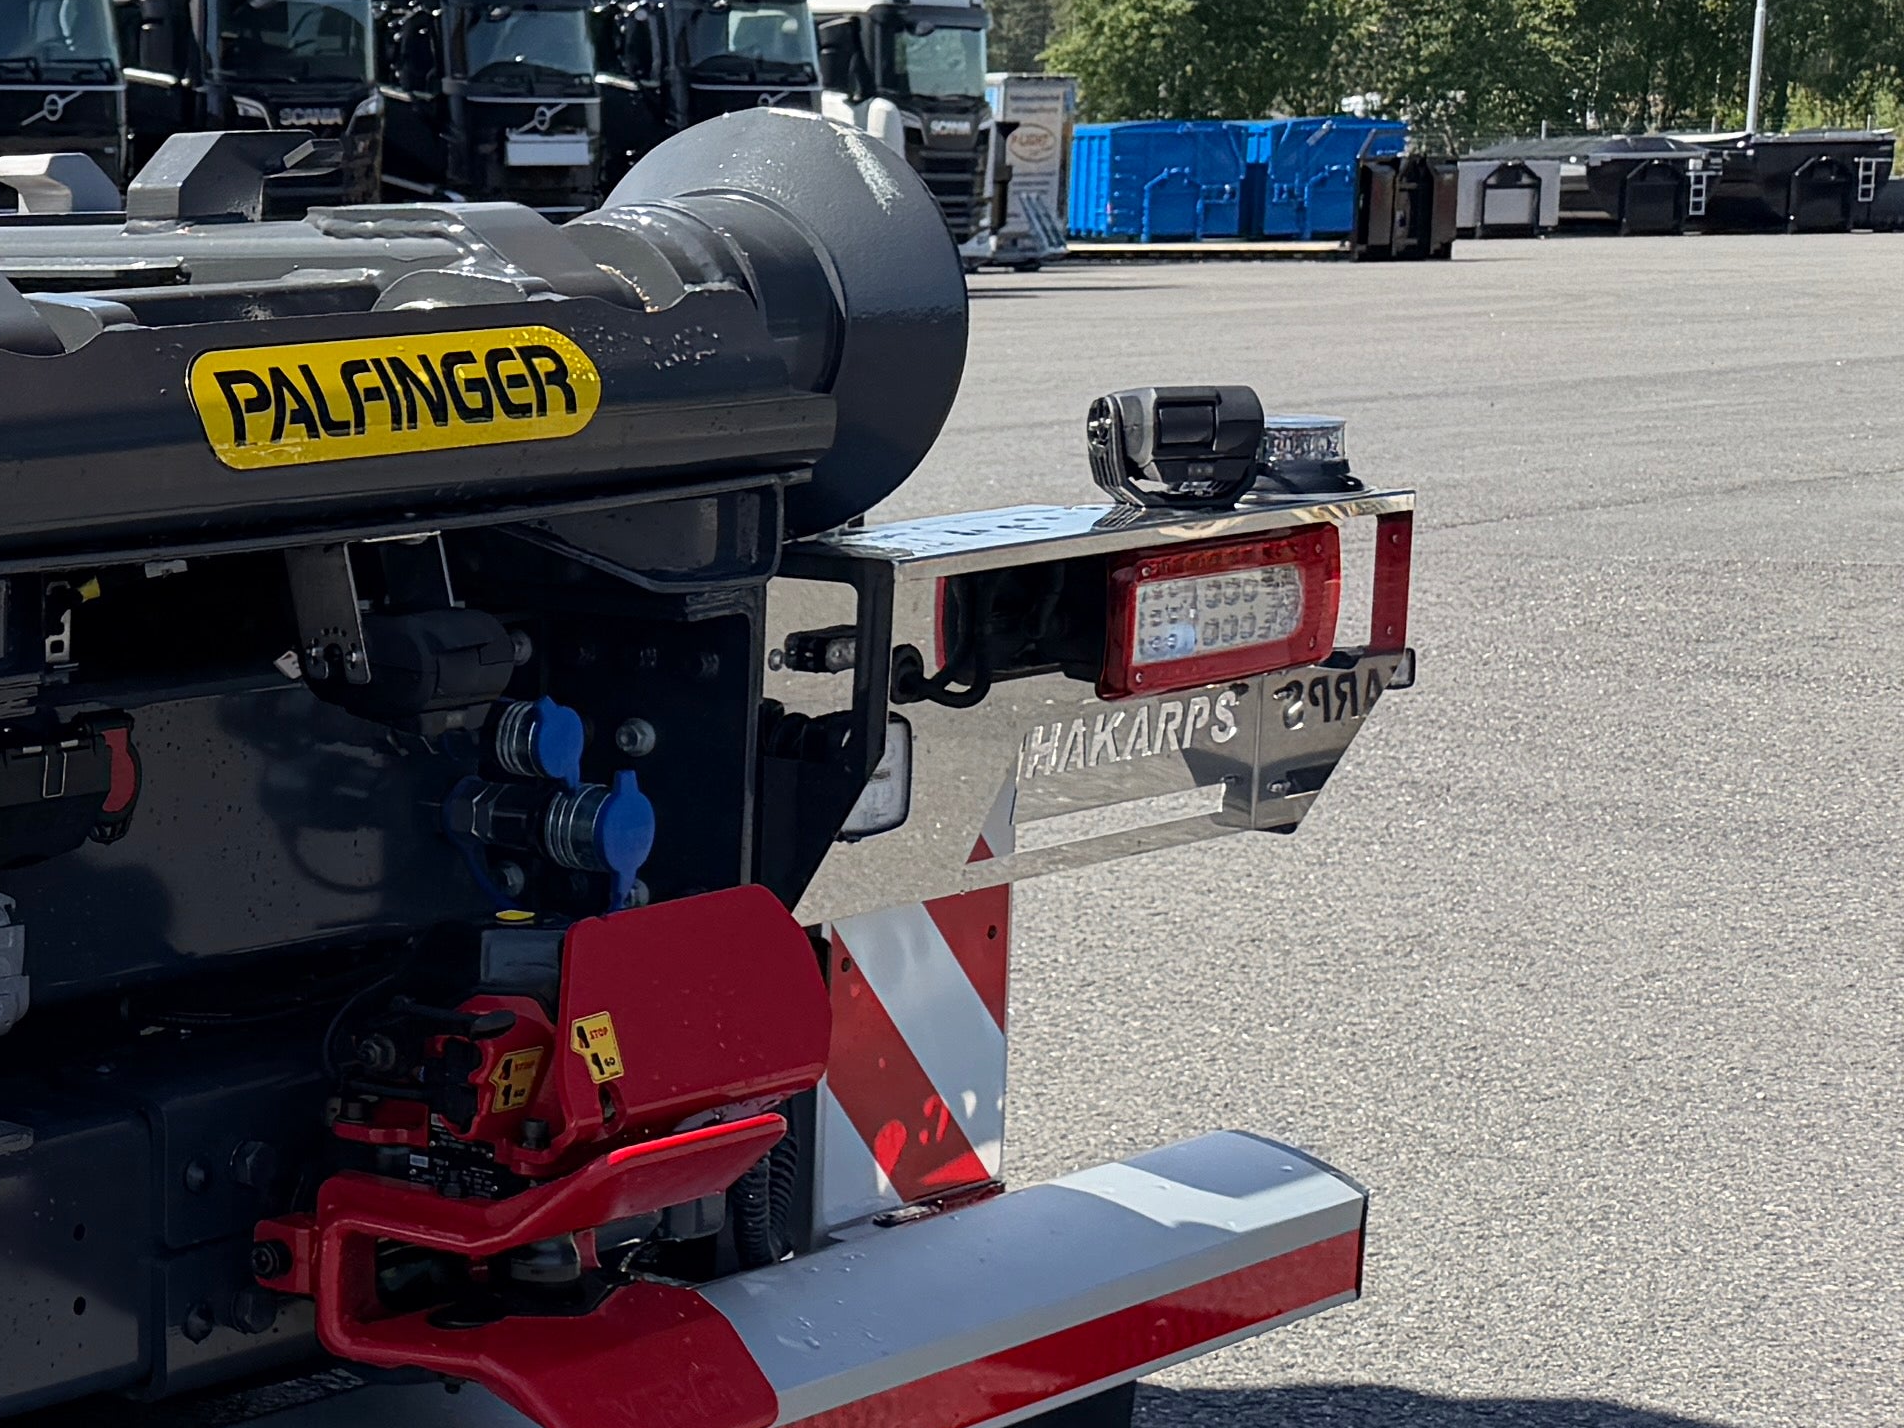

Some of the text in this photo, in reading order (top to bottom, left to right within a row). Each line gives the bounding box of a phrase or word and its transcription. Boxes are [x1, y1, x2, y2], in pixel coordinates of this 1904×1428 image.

[212, 344, 578, 447] PALFINGER
[1024, 689, 1239, 781] HAKARPS
[589, 1026, 609, 1040] STOP
